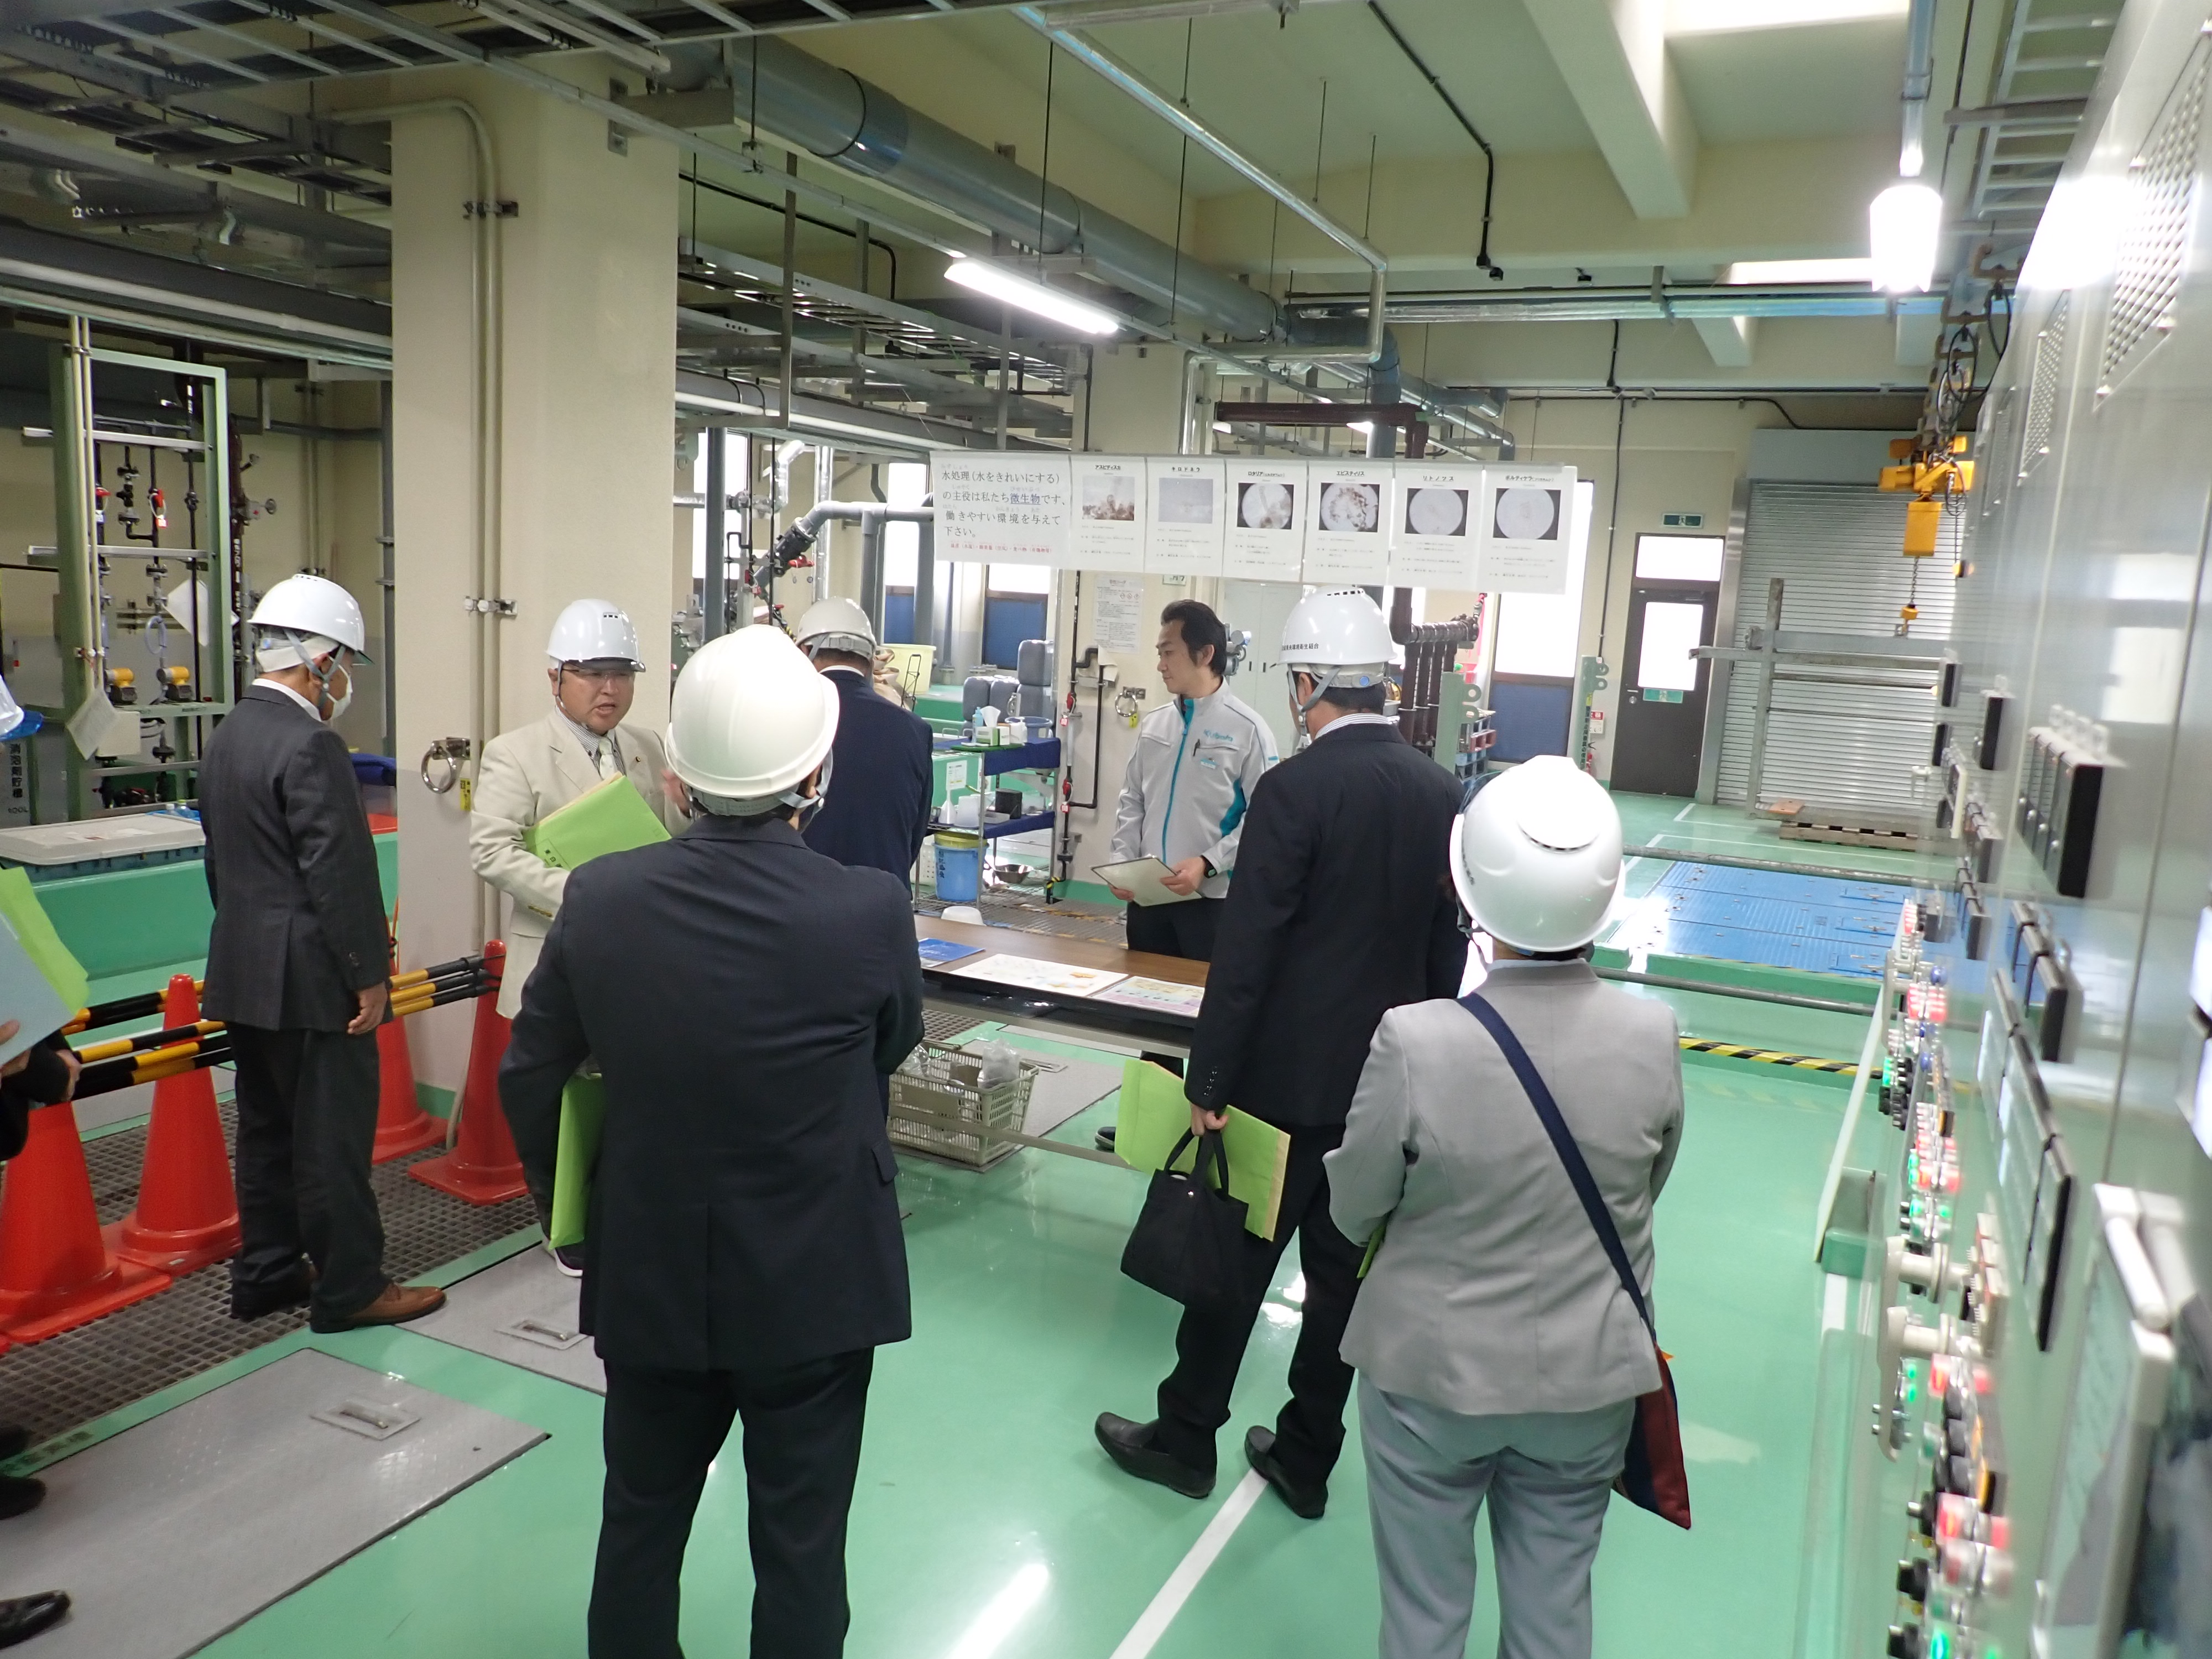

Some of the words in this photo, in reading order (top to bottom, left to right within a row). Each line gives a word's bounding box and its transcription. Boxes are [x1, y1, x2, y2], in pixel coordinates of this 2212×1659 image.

[946, 510, 1061, 525] 働きやすい環境を与えて
[945, 526, 976, 538] 下さい。
